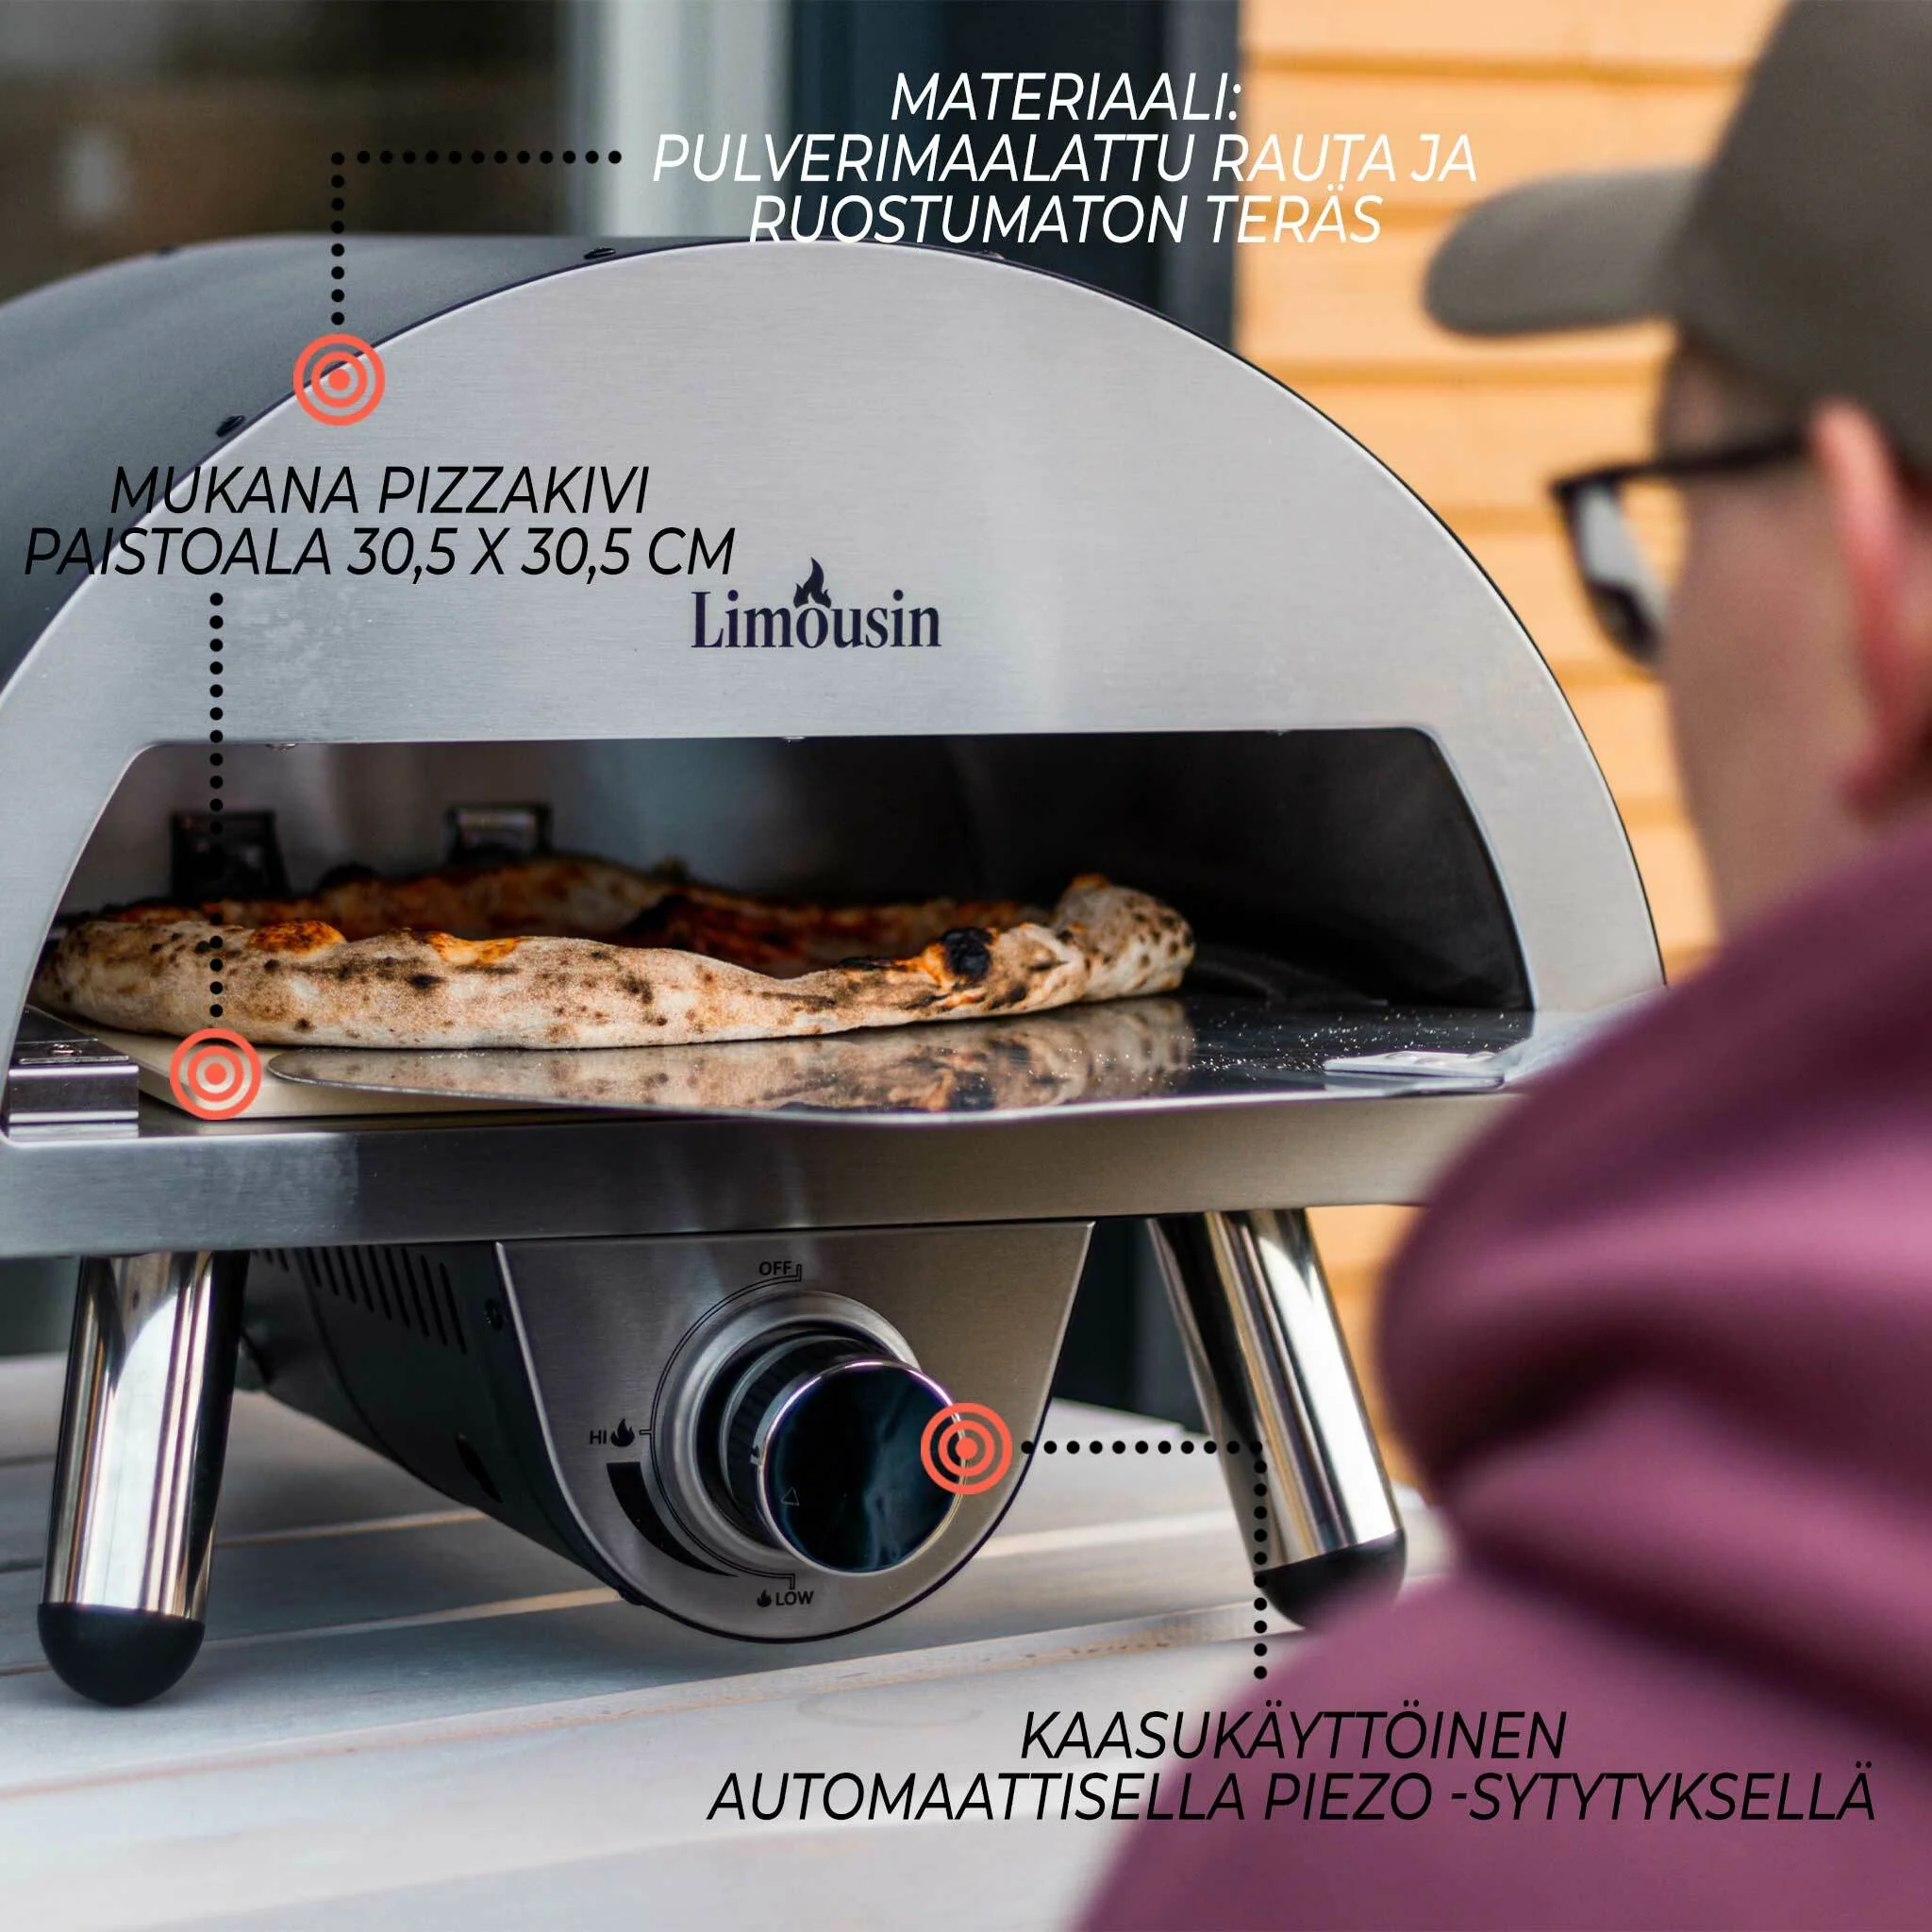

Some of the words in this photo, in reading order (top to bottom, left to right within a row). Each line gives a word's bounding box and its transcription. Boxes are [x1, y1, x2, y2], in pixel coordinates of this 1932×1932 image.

[691, 589, 942, 651] Limousin
[758, 1260, 792, 1276] OFF
[589, 1429, 608, 1445] HI
[775, 1591, 814, 1607] LOW
